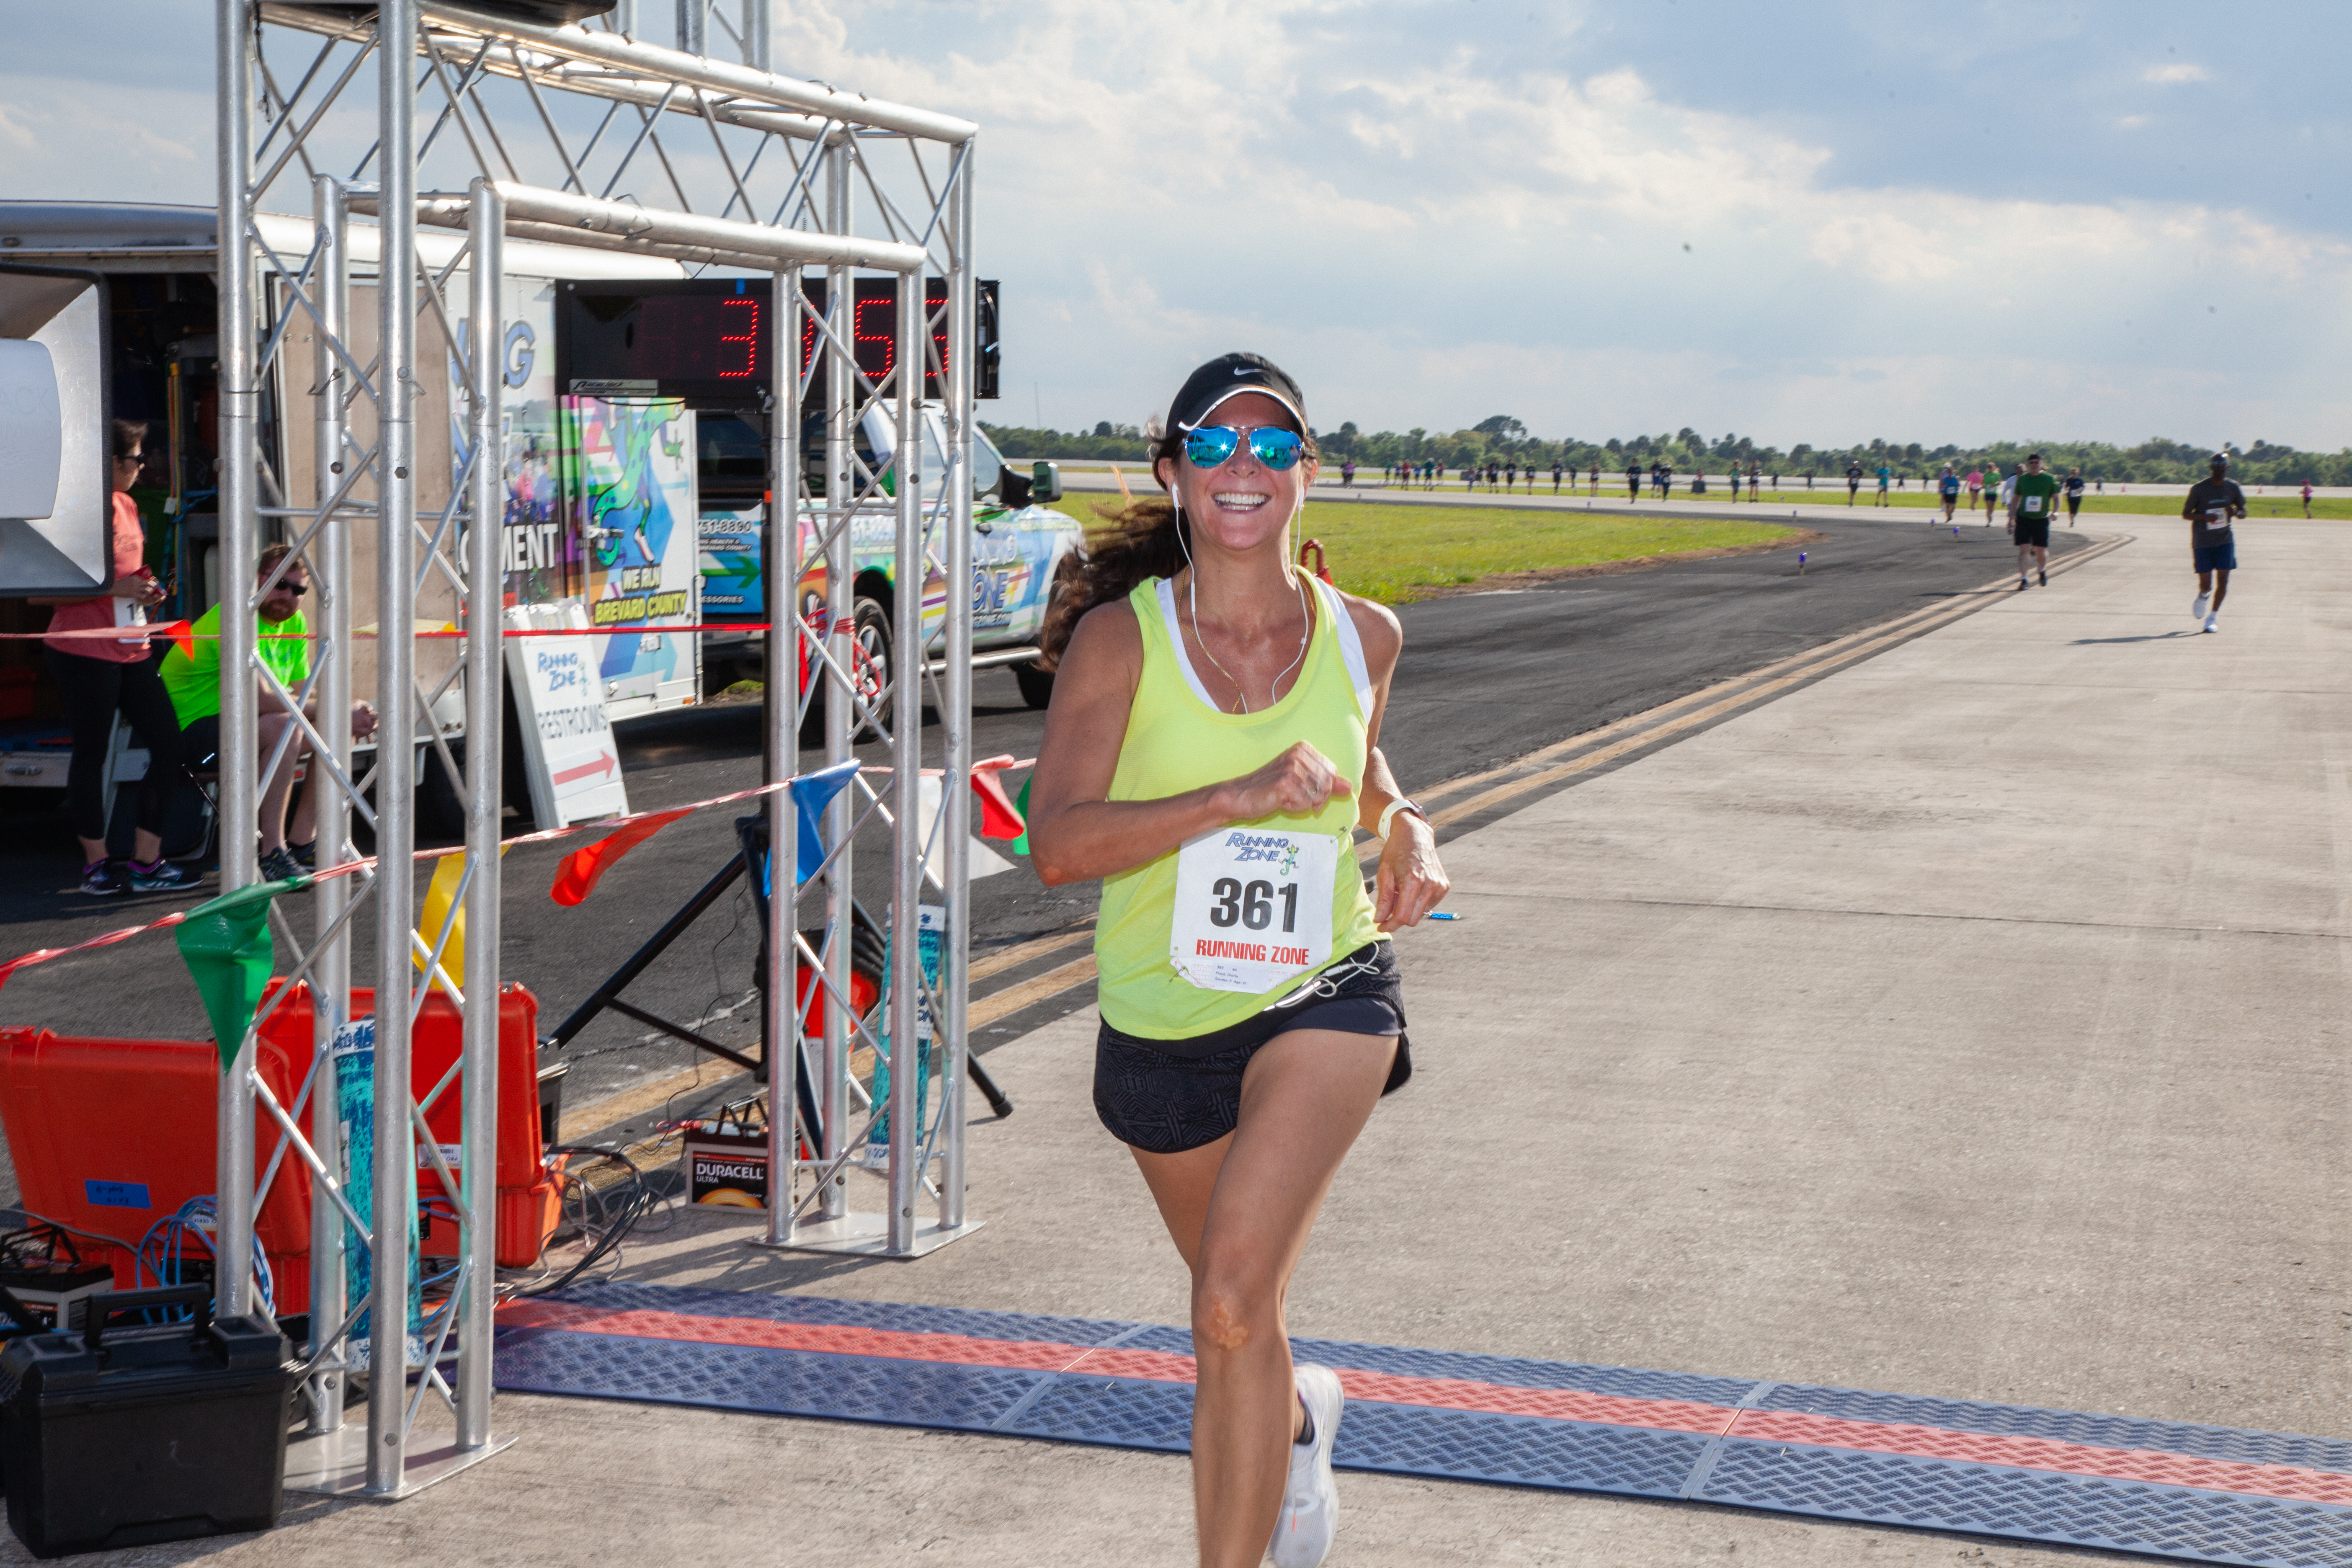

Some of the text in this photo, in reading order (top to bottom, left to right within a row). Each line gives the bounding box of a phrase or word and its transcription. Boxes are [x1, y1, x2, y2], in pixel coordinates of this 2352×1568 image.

[622, 563, 661, 591] WE RUN
[972, 567, 1010, 612] ONE
[594, 591, 687, 624] BREVARD COUNTY
[537, 704, 607, 740] RESTROOMS
[1225, 832, 1289, 848] RUNNING
[1234, 847, 1280, 861] ZONE
[1210, 877, 1298, 933] 361
[1196, 939, 1309, 965] RUNNING ZONE
[696, 1163, 764, 1180] DURACELL
[696, 1175, 719, 1184] ULTRA
